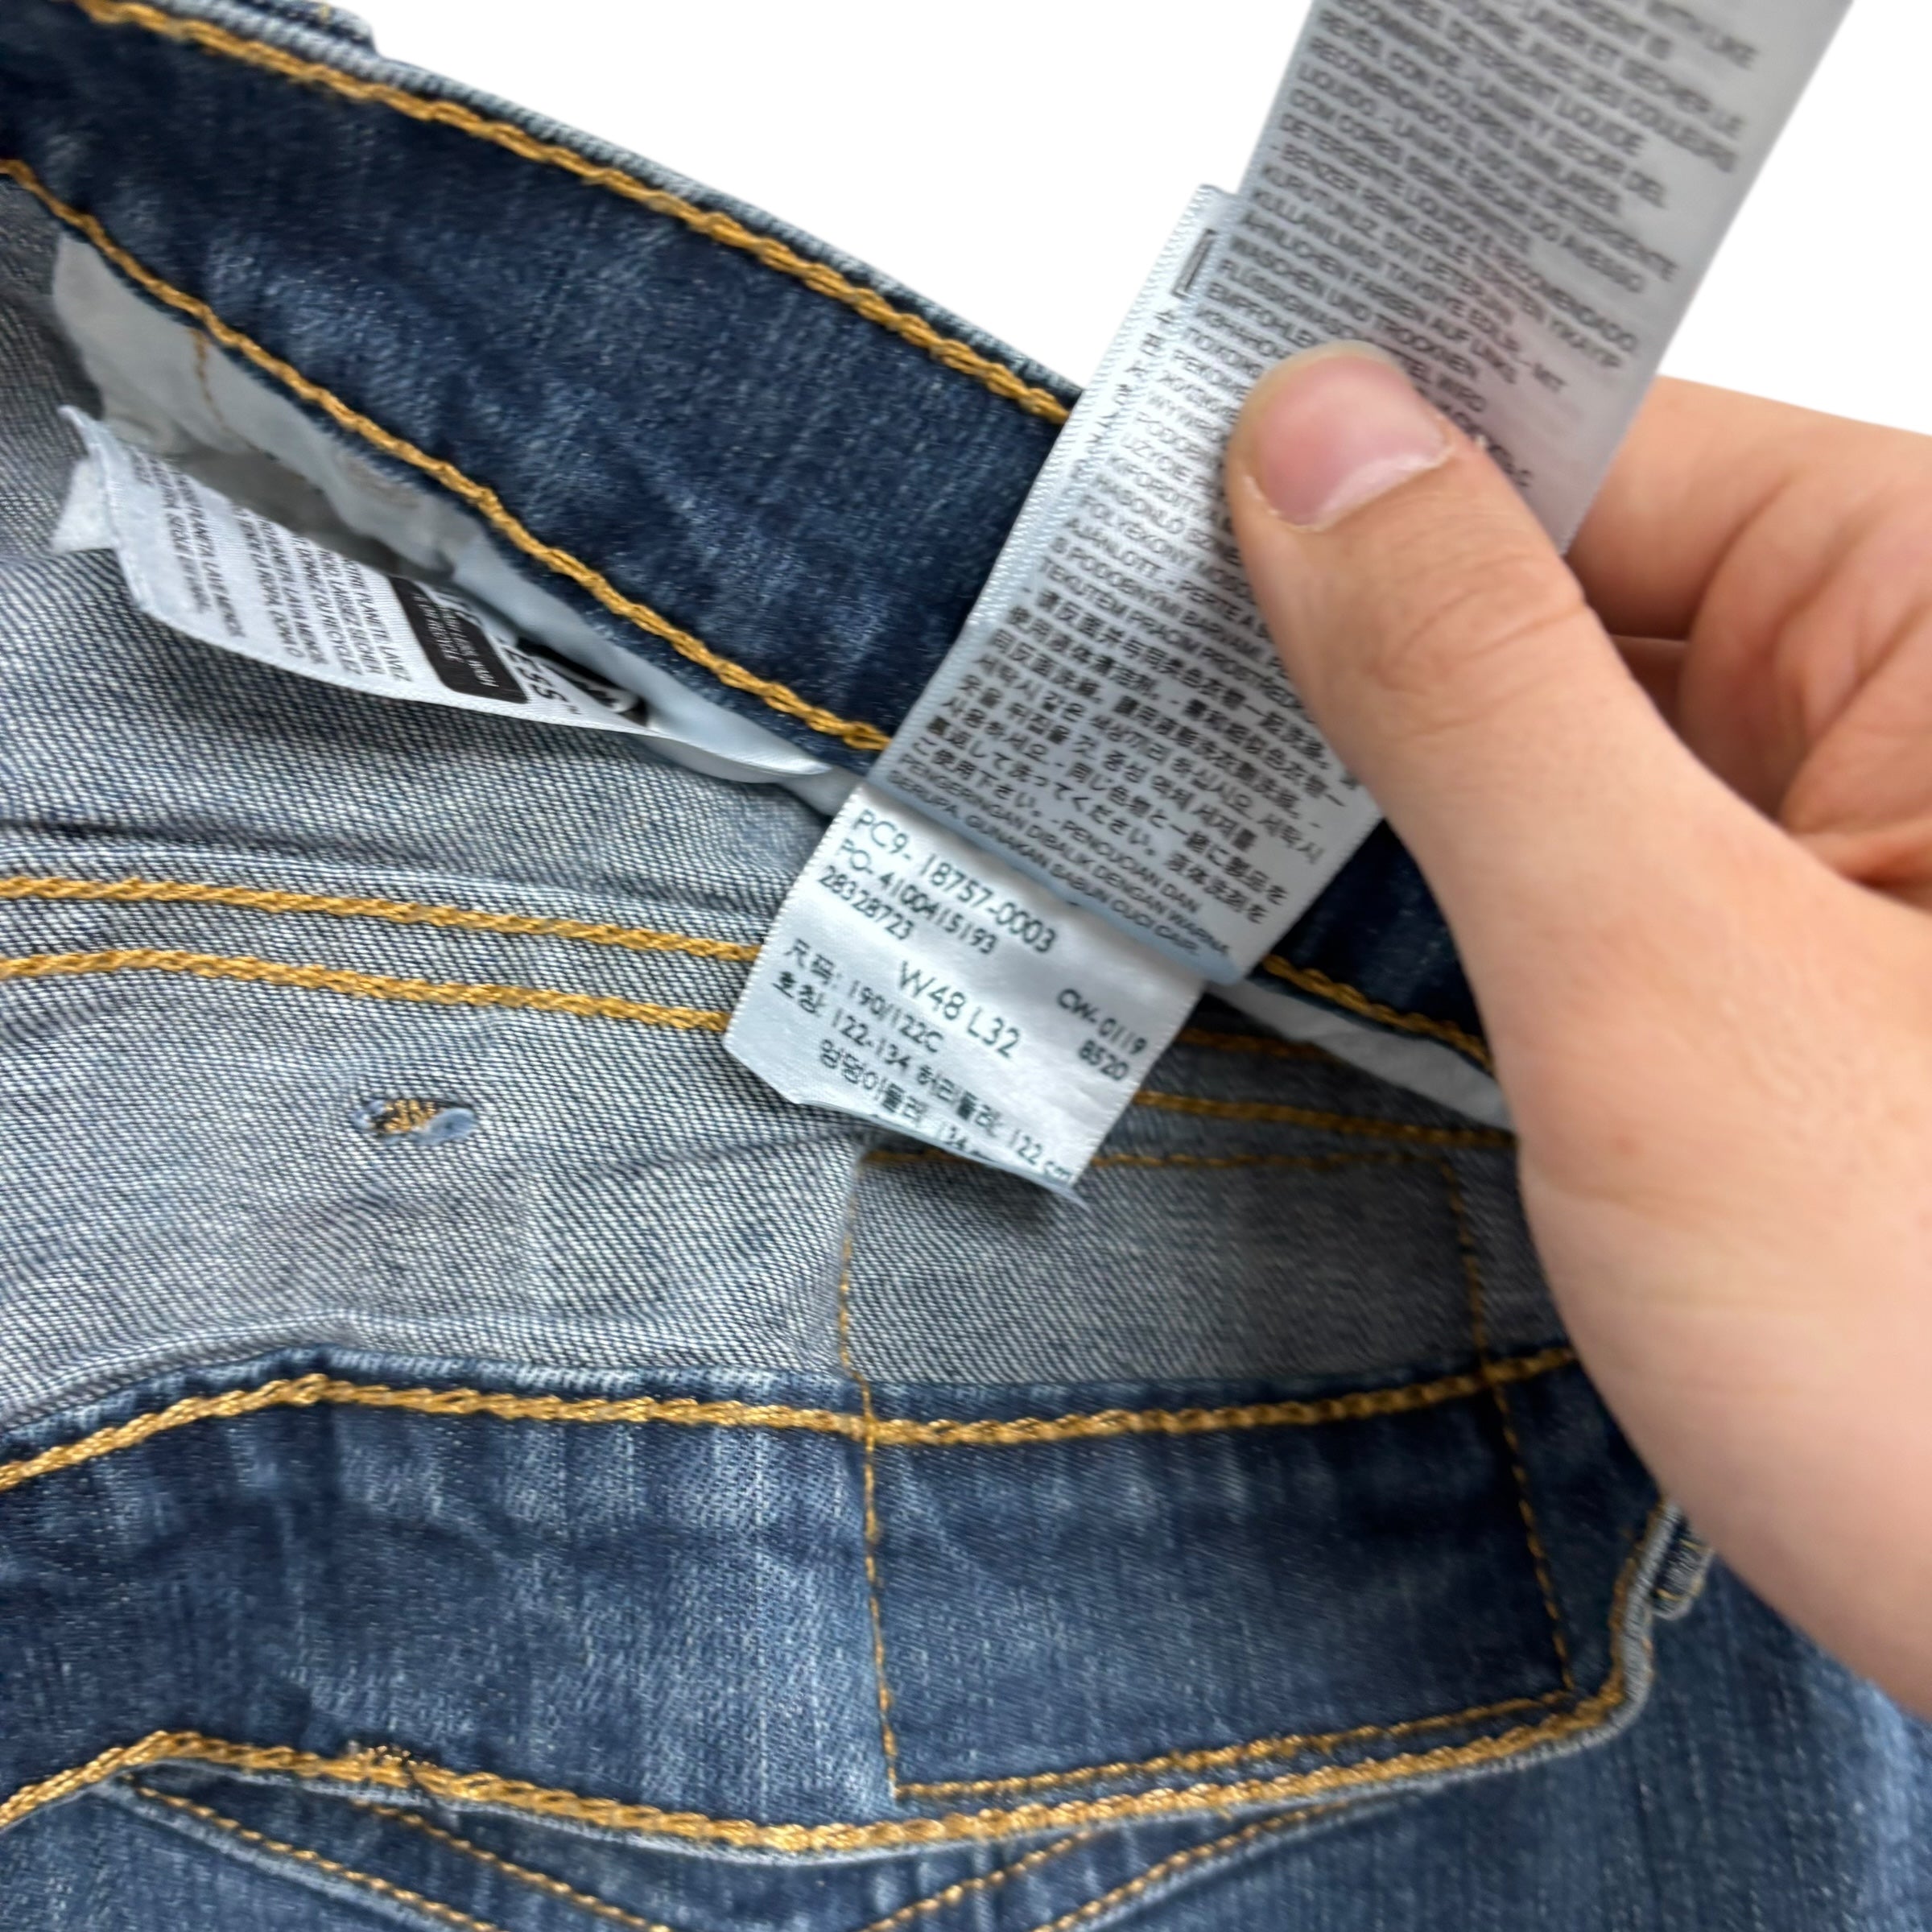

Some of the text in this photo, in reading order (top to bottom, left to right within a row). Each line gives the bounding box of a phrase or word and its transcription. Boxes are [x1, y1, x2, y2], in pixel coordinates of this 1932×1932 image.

[1327, 286, 1373, 321] UND
[1426, 314, 1473, 349] AUF
[970, 648, 1044, 702] 세탁시
[1039, 688, 1087, 724] 같은
[815, 863, 917, 943] 28328723
[846, 977, 947, 1055] 190/122C
[891, 958, 1025, 1059] W48 L32
[828, 1006, 914, 1075] 122-134
[1005, 1128, 1046, 1166] 122
[1075, 1037, 1133, 1084] 8520
